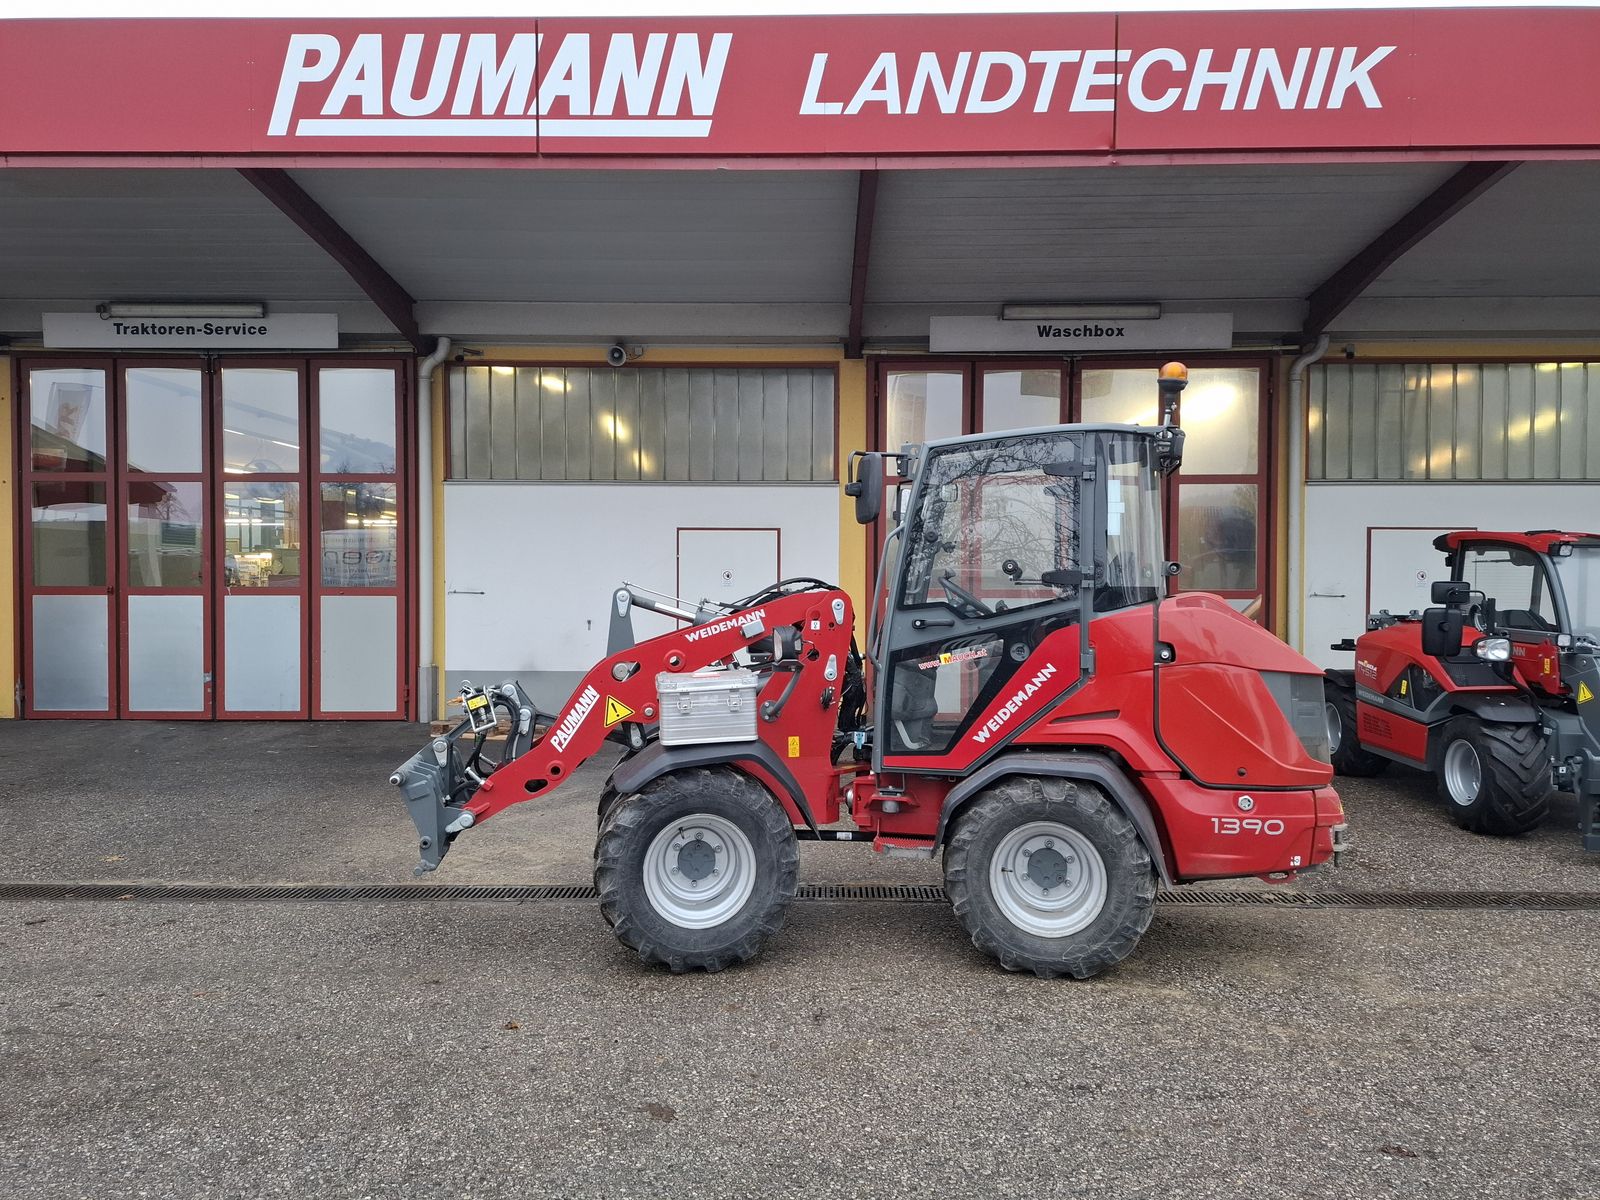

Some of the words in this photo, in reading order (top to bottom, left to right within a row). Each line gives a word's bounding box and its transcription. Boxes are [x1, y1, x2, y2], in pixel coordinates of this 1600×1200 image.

[267, 32, 733, 137] PAUMANN
[799, 46, 1397, 116] LANDTECHNIK
[113, 322, 268, 336] Traktoren-Service
[1036, 324, 1126, 338] Waschbox
[684, 608, 766, 642] WEIDEMANN
[550, 684, 601, 753] PAUMANN
[972, 662, 1057, 744] WEIDEMANN
[1211, 817, 1285, 835] 1390
